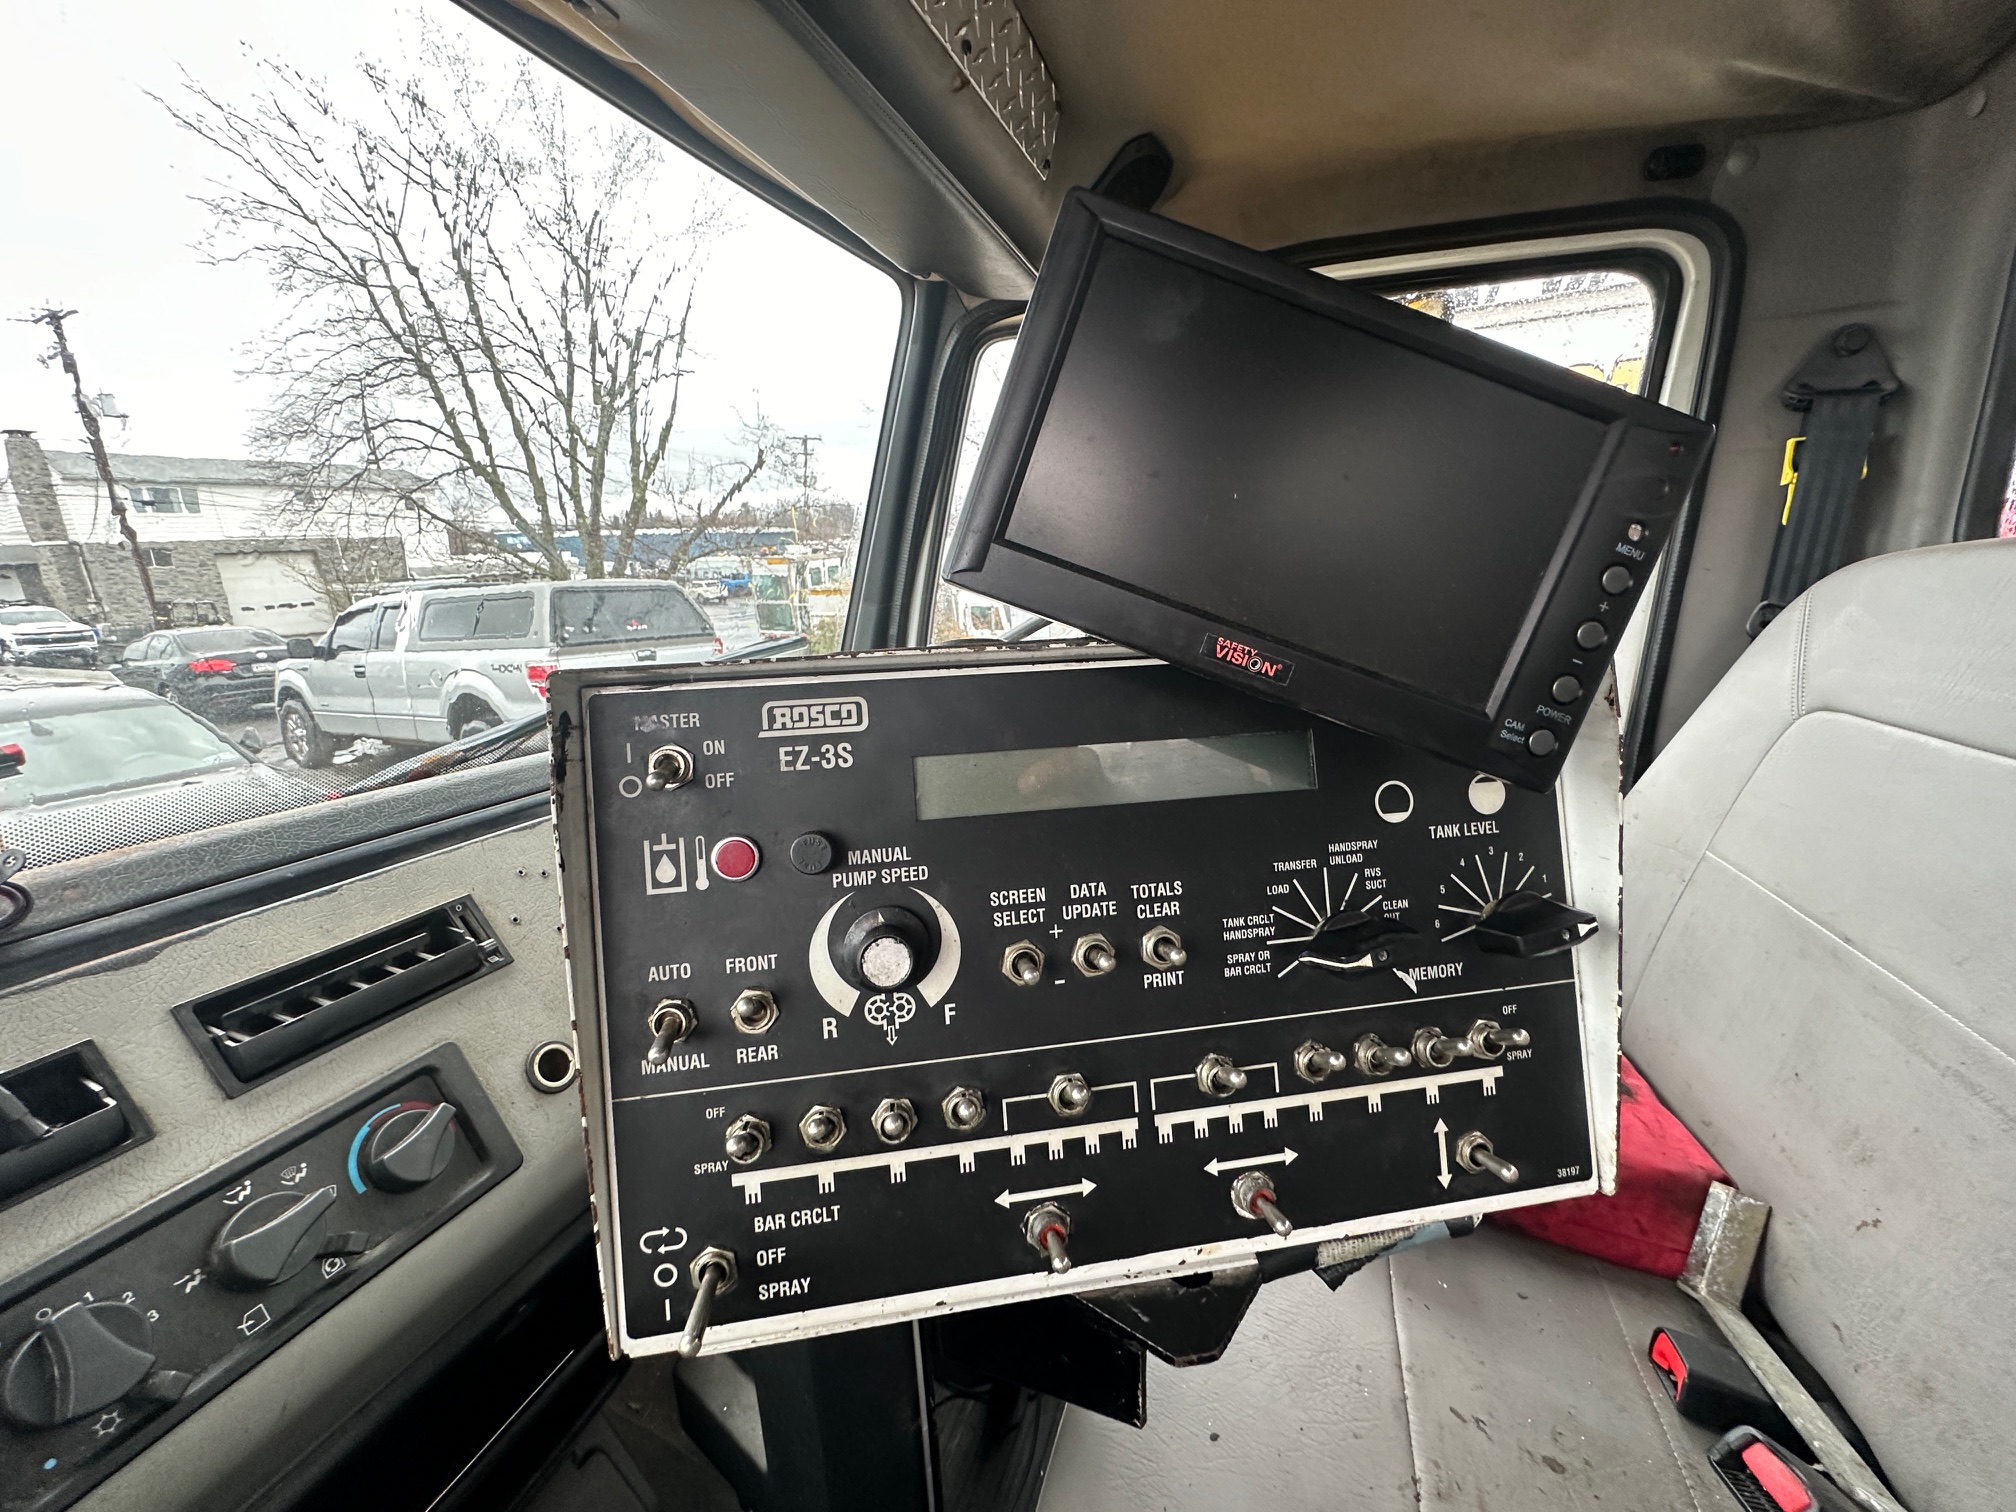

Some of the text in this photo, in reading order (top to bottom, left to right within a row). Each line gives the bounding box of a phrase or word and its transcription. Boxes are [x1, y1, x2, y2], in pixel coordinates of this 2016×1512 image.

[1616, 542, 1646, 561] MENU
[1217, 637, 1258, 656] SAFETY
[772, 703, 859, 729] ROSCO
[1536, 704, 1572, 725] POWER
[1504, 718, 1525, 731] CAM
[1500, 729, 1525, 744] Select
[703, 740, 725, 756] ON
[778, 742, 854, 772] EZ-3S
[705, 773, 735, 789] OFF
[1429, 820, 1499, 839] TANK LEVEL
[1328, 839, 1378, 853] HANDSPRAY
[1489, 846, 1494, 855] 3
[848, 846, 911, 865] MANUAL
[1329, 853, 1363, 866] UNLOAD
[1460, 858, 1465, 867] 4
[1518, 852, 1524, 861] 2
[1273, 859, 1317, 872] TRANSFER
[1364, 867, 1381, 877] RVS
[832, 865, 929, 888] PUMP SPEED
[1365, 879, 1387, 890] SUCT
[989, 887, 1046, 907] SCREEN
[1070, 882, 1107, 899] DATA
[1131, 880, 1183, 899] TOTALS
[1267, 884, 1290, 895] LOAD
[1440, 885, 1446, 894] 5
[1062, 901, 1118, 920] UPDATE
[1136, 901, 1180, 919] CLEAR
[1383, 899, 1409, 911] CLEAN
[993, 908, 1046, 927] SELECT
[1222, 914, 1275, 928] TANK CRCLT
[1435, 919, 1440, 928] 6
[1223, 926, 1276, 941] HANDSPRAY
[725, 954, 778, 974] FRONT
[1227, 950, 1270, 964] SPRAY OR
[648, 963, 692, 982] AUTO
[1224, 963, 1271, 977] BAR CRCLT
[1408, 962, 1463, 981] MEMORY
[1144, 970, 1184, 989] PRINT
[944, 1003, 956, 1025] F
[1502, 1004, 1518, 1015] OFF
[822, 1017, 838, 1039] R
[736, 1045, 779, 1064] REAR
[1506, 1049, 1533, 1061] SPRAY
[641, 1053, 711, 1075] MANUAL
[706, 1107, 726, 1120] OFF
[694, 1160, 729, 1175] SPRAY
[1557, 1166, 1580, 1178] 38197
[754, 1205, 841, 1233] BAR CRCLT
[756, 1247, 787, 1267] OFF
[83, 1291, 94, 1301] 1
[758, 1277, 811, 1300] SPRAY
[122, 1291, 136, 1304] 2
[147, 1309, 160, 1322] 3
